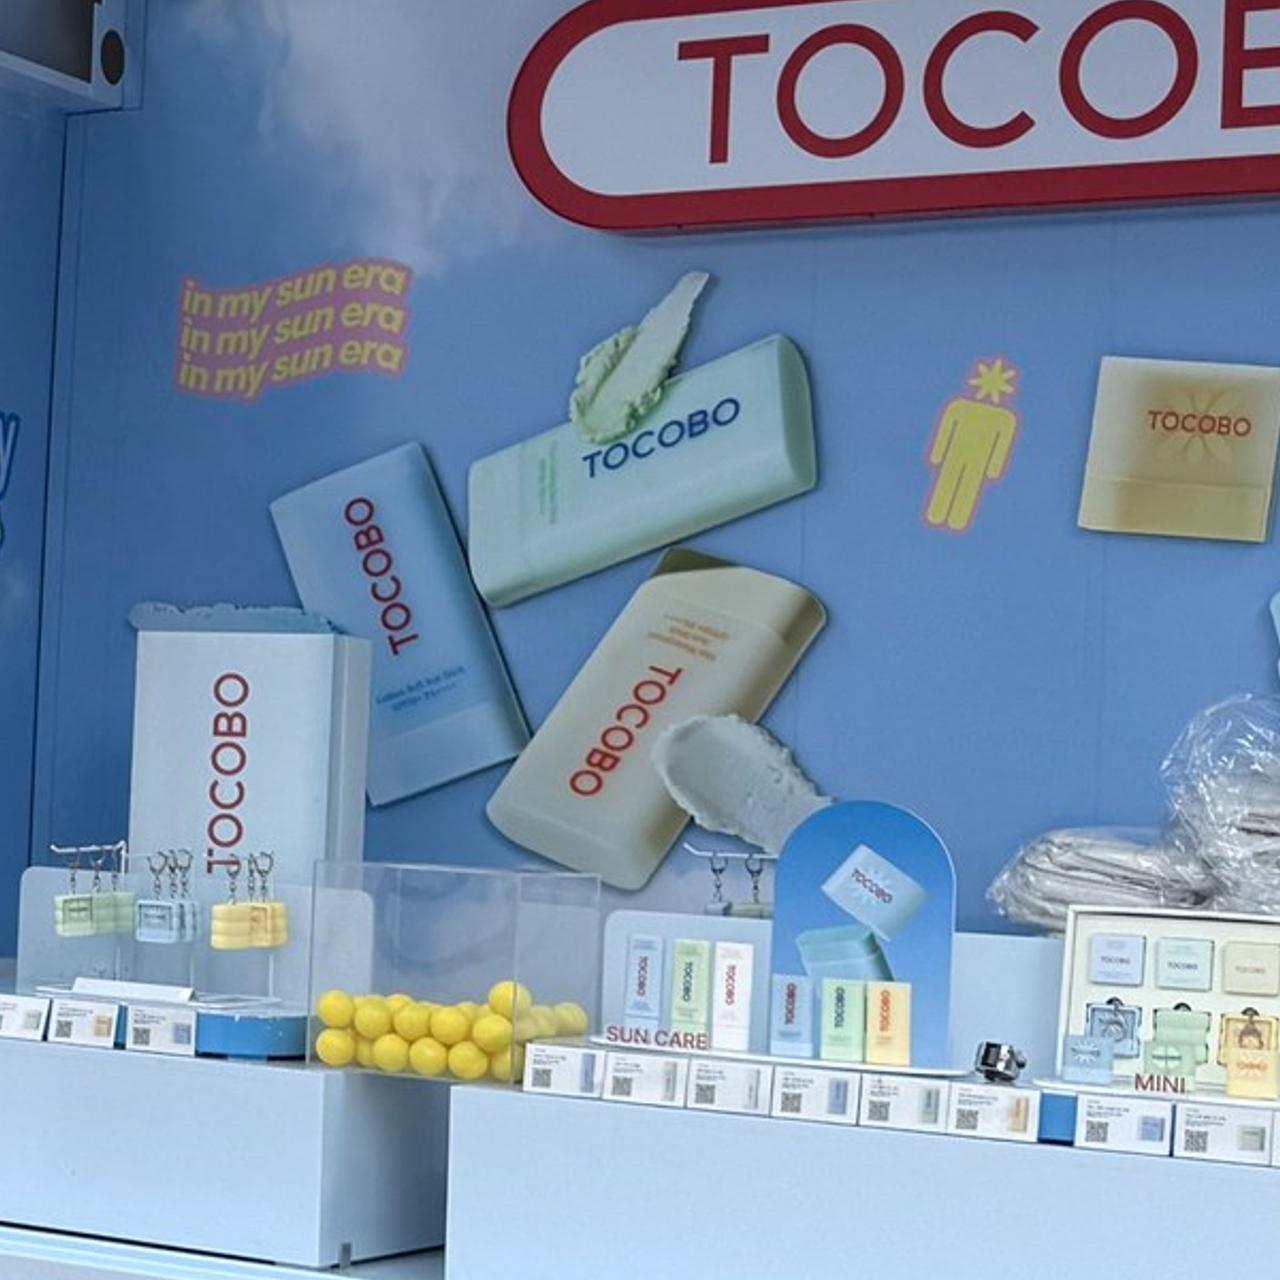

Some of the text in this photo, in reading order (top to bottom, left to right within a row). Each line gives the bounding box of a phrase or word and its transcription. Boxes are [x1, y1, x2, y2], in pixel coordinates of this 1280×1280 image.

[183, 265, 407, 323] in my sun era
[181, 302, 405, 360] in my sun era
[179, 340, 403, 398] in my sun era
[582, 398, 740, 478] TOCOBO
[1147, 409, 1252, 438] TOCOBO
[345, 496, 419, 656] TOCOBO
[570, 665, 683, 796] TOCOBO
[207, 673, 249, 874] TOCOBO
[606, 1025, 710, 1051] SUN CARE
[1134, 1073, 1186, 1094] MINI
